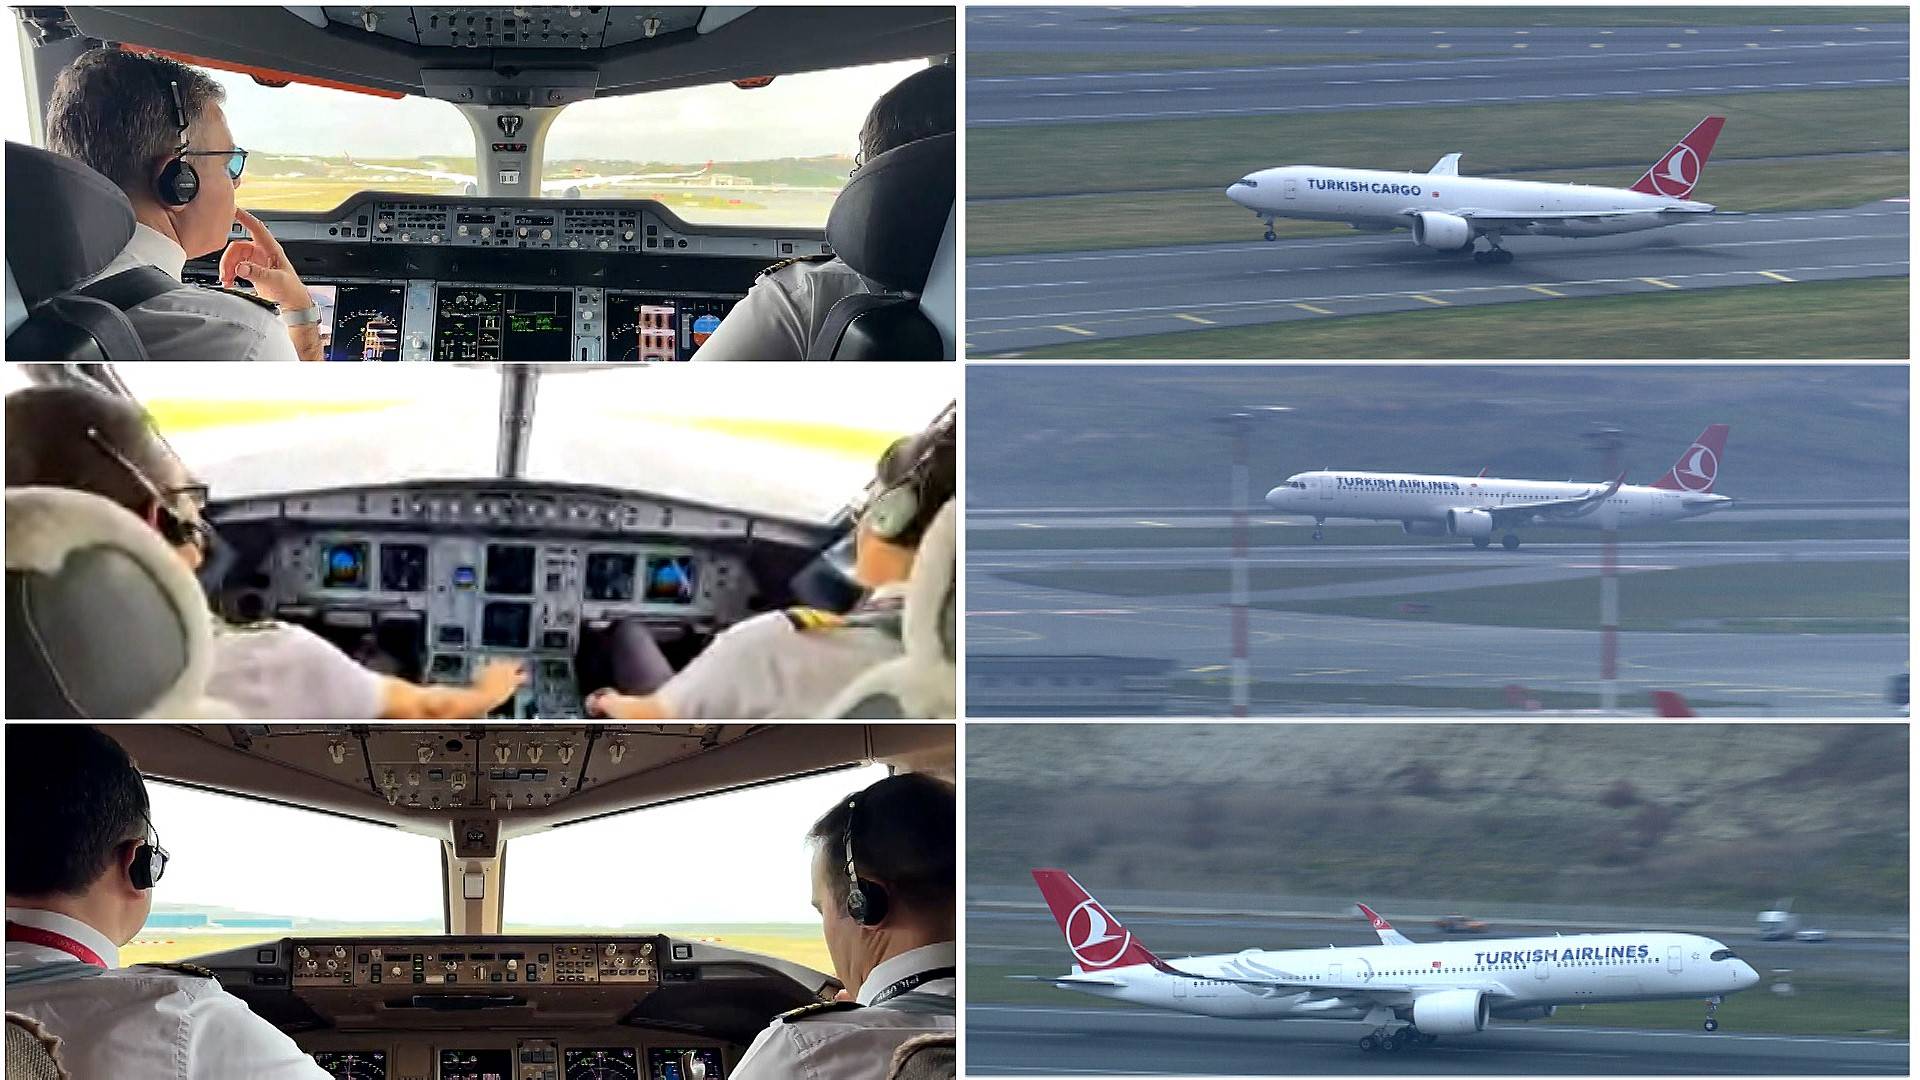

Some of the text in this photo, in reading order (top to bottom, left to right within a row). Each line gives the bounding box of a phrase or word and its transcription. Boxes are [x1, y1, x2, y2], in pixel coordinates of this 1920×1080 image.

[1307, 179, 1422, 196] TURKISH CARGO
[1336, 477, 1460, 490] TURKISH AIRLINES
[1475, 945, 1649, 965] TURKISH AIRLINES
